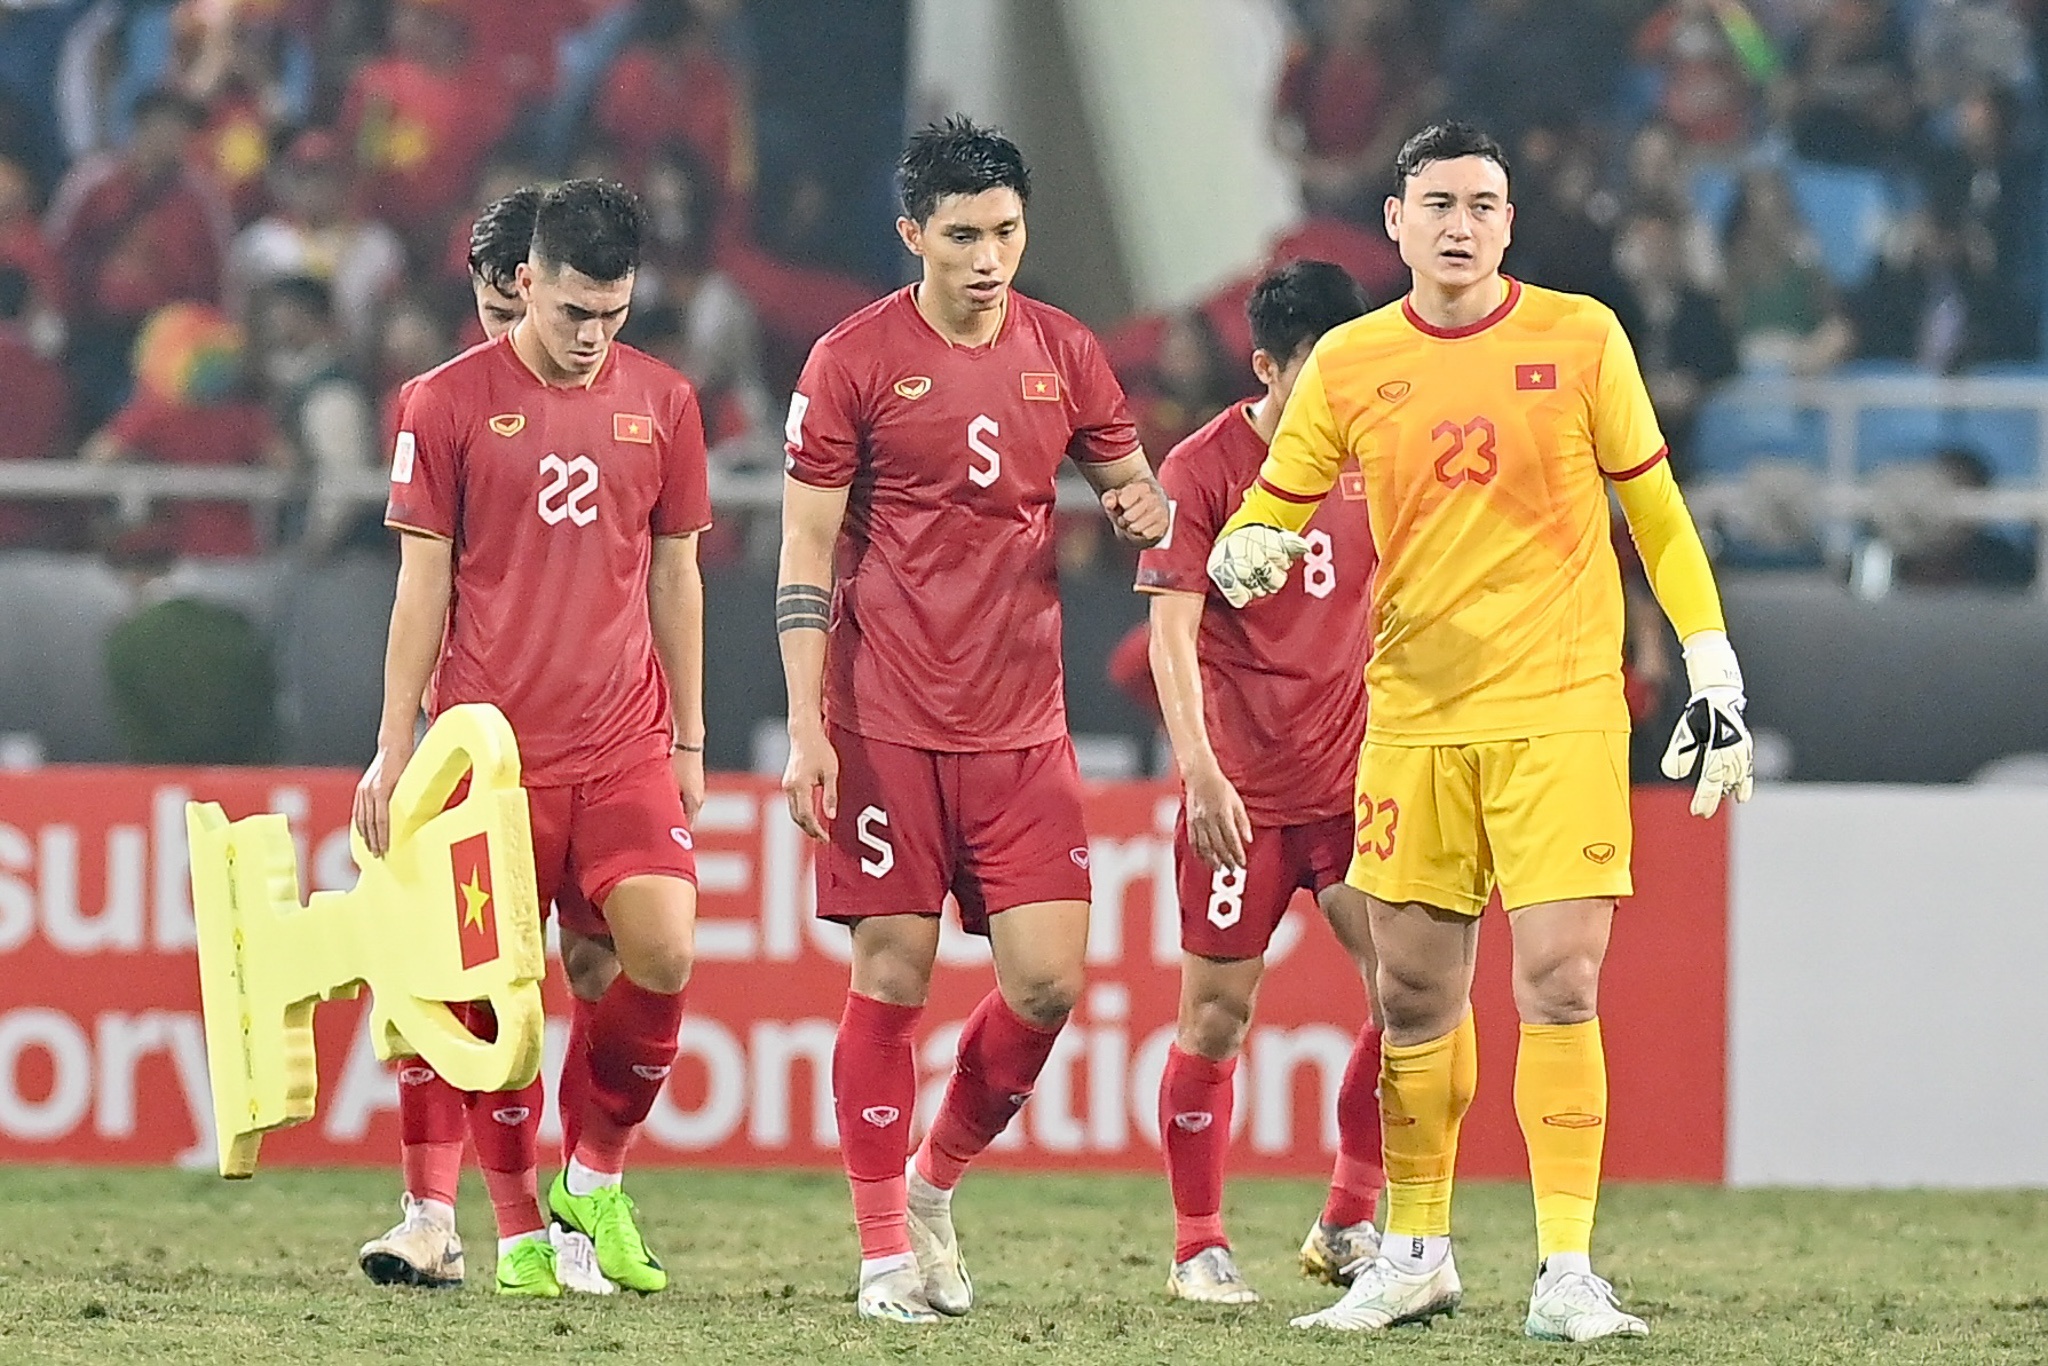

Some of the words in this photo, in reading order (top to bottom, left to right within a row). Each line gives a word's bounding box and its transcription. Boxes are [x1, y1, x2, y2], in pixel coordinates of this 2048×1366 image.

[1431, 415, 1498, 490] 23
[537, 453, 600, 527] 22
[1303, 528, 1336, 599] 8
[1356, 792, 1399, 861] 23
[1207, 863, 1248, 931] 8
